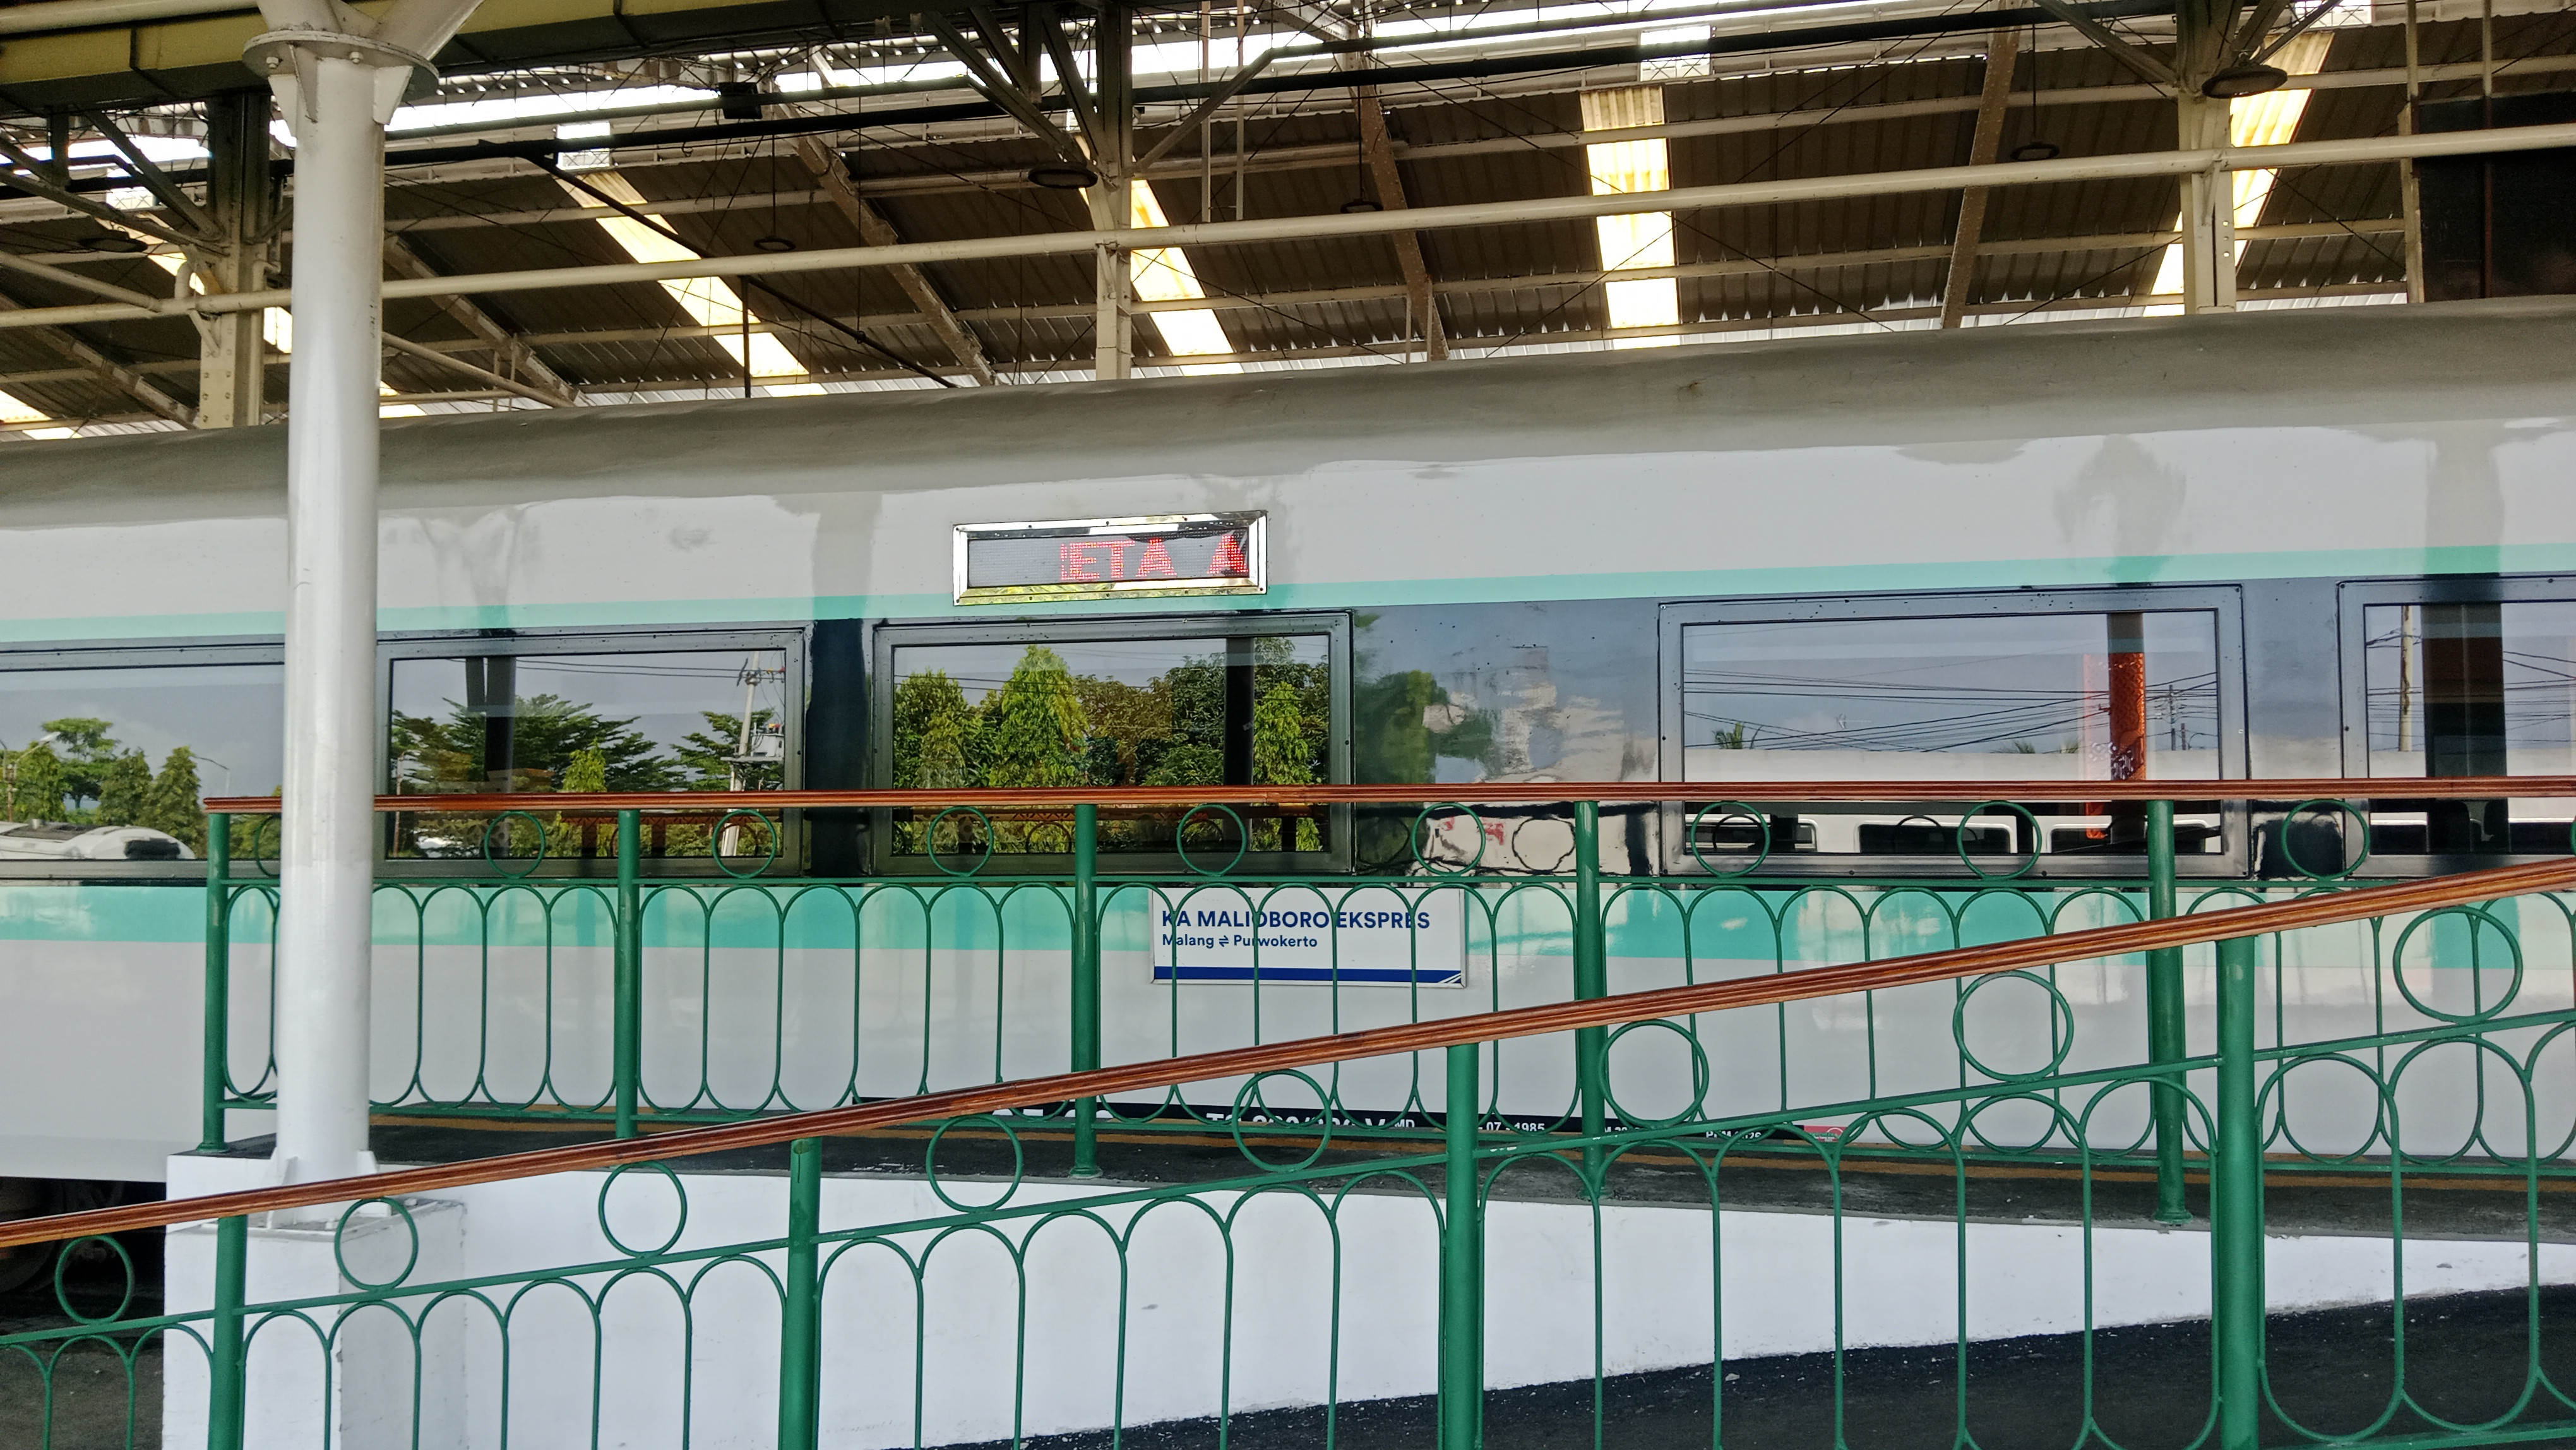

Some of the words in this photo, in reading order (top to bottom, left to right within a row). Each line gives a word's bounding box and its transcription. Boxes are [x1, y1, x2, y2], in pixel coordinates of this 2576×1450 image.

[1061, 537, 1178, 580] ETA
[1162, 910, 1191, 926] KA
[1337, 911, 1430, 929] EKSPRES
[1162, 933, 1214, 949] Malang
